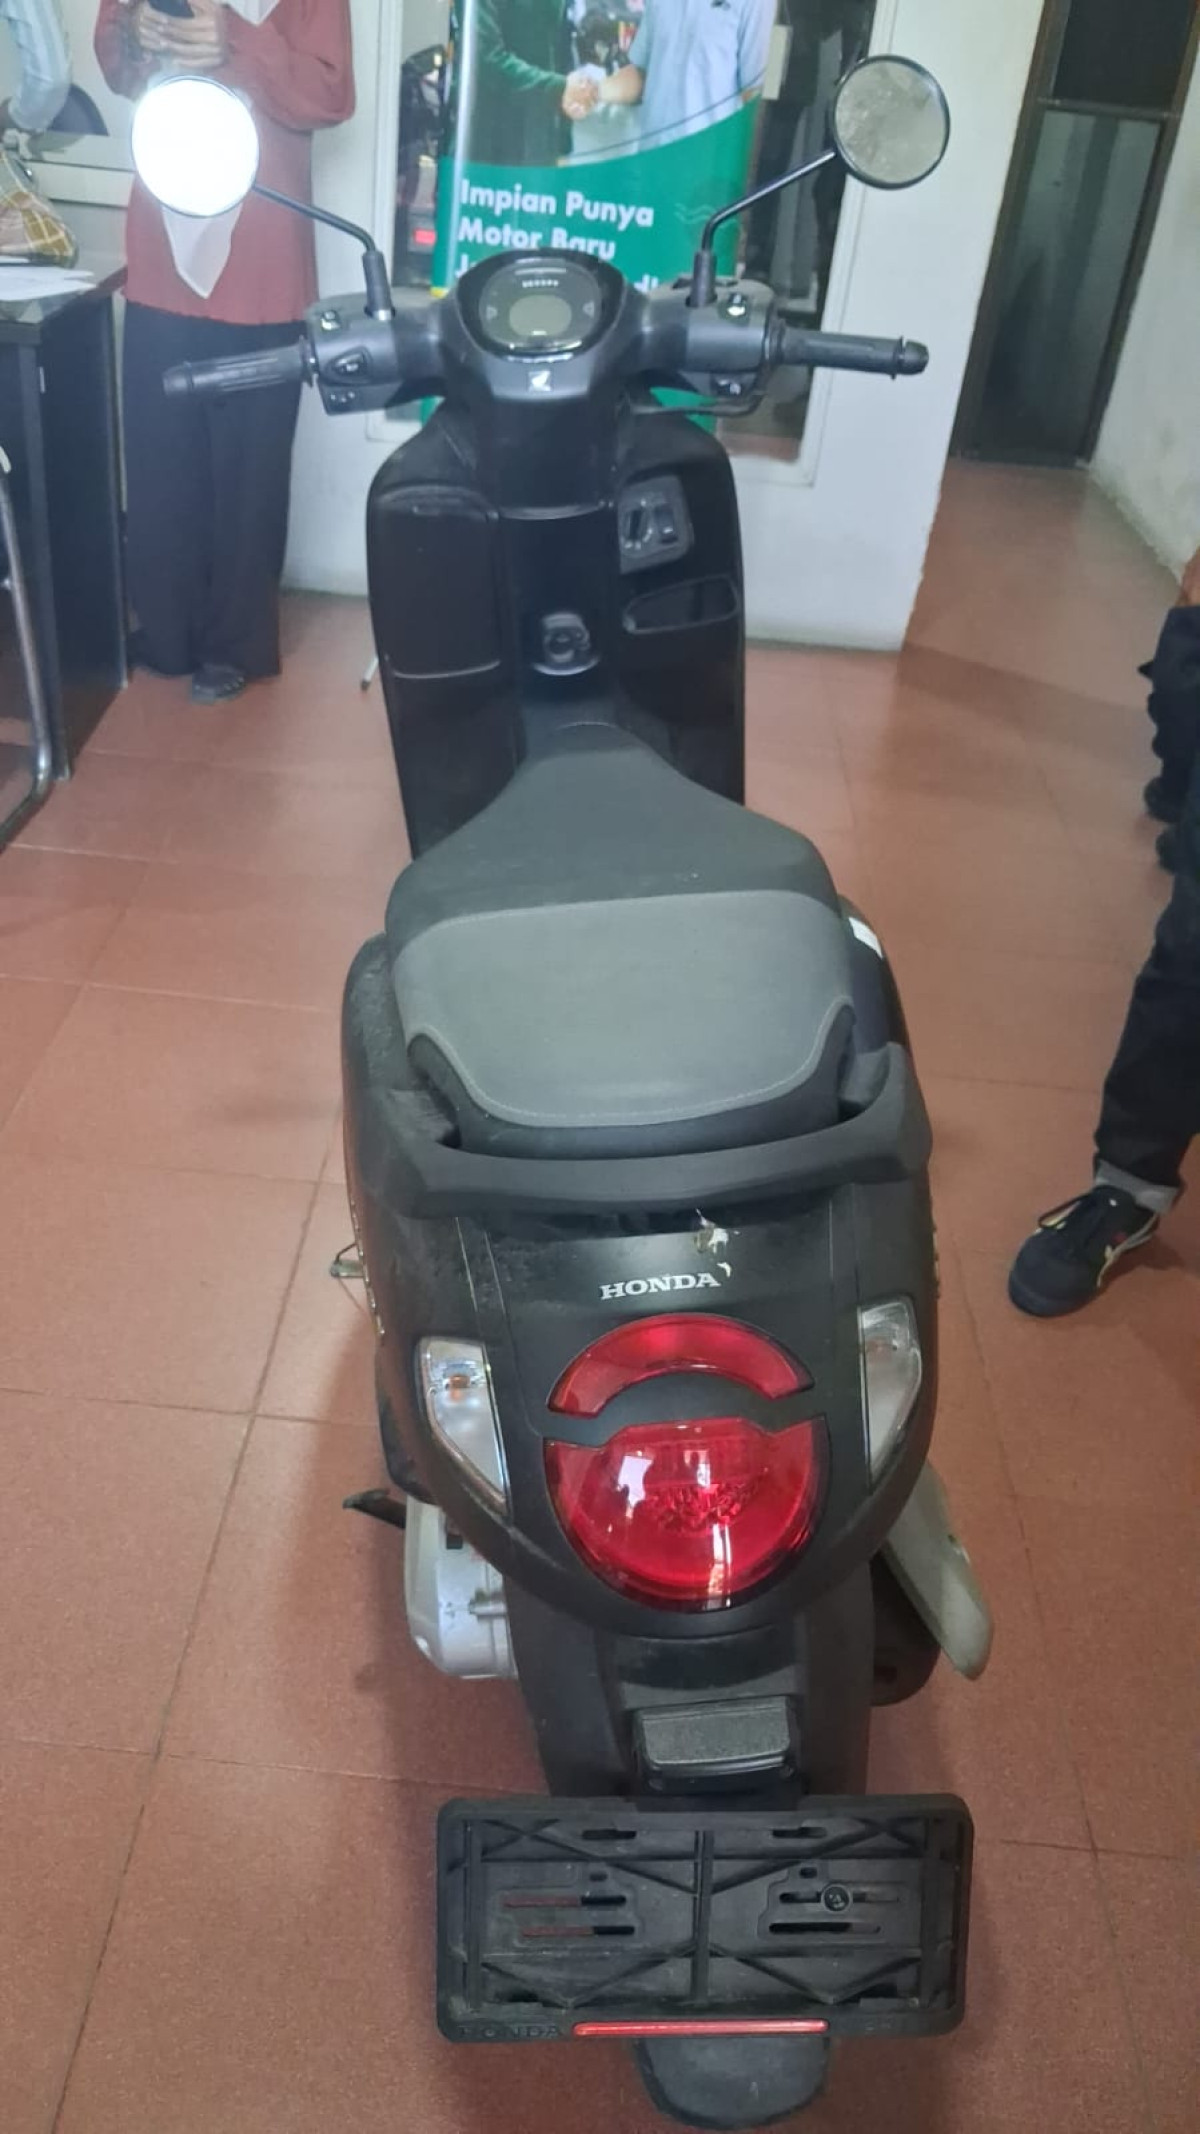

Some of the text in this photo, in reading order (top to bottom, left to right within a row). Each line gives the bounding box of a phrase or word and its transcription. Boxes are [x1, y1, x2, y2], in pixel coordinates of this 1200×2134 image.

[460, 179, 654, 231] Impian Punya
[458, 217, 543, 249] Motor
[600, 1273, 721, 1299] HONDA
